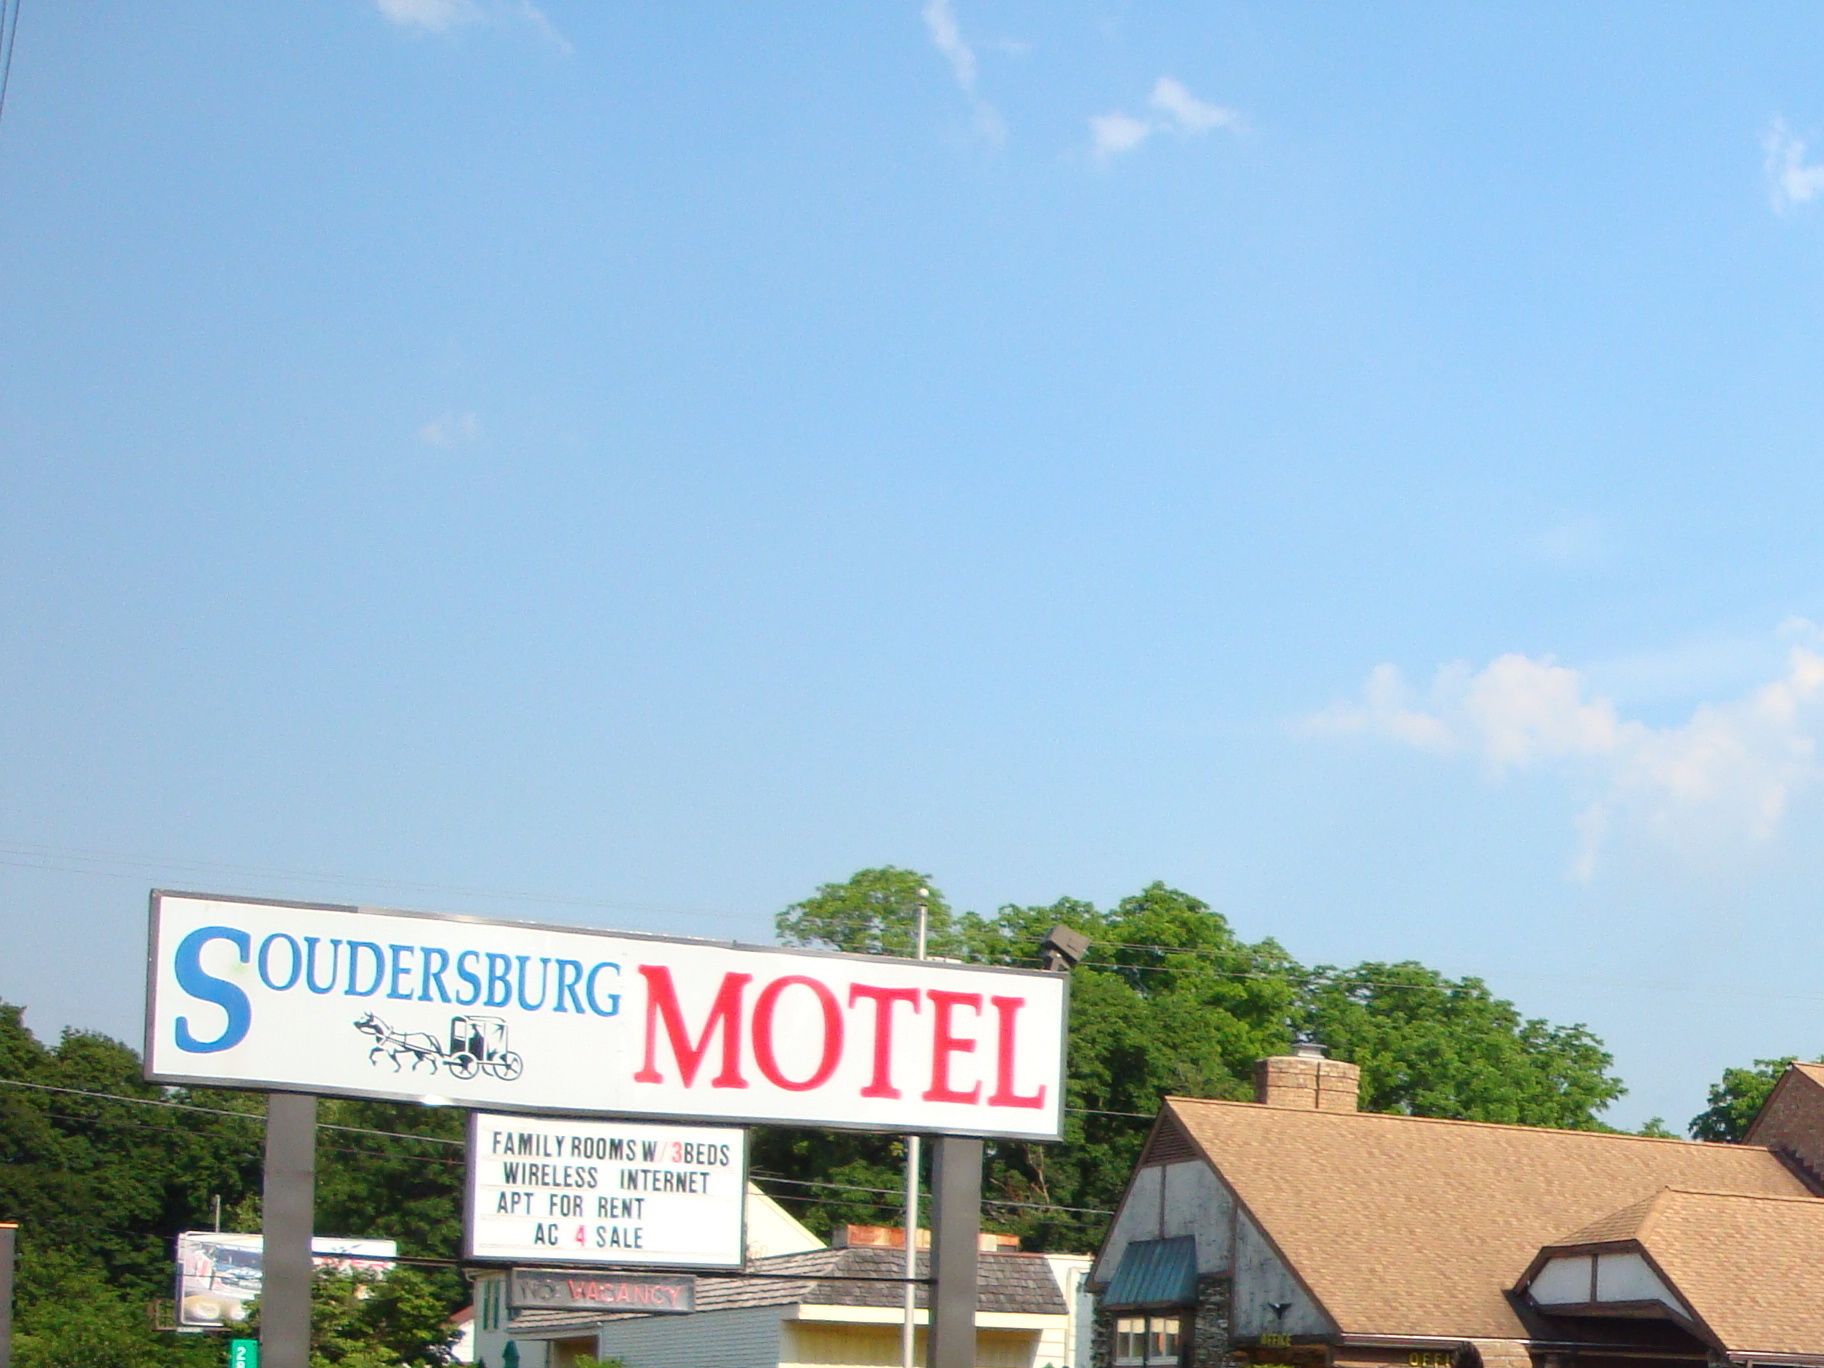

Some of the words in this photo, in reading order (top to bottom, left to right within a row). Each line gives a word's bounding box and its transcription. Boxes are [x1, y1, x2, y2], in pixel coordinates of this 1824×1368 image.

[174, 925, 623, 1054] SOUDERSBURG
[633, 964, 1047, 1111] MOTEL
[492, 1131, 566, 1157] FAMILY
[571, 1136, 636, 1161] ROOMS
[503, 1161, 598, 1189] WIRELESS
[620, 1168, 711, 1194] INTERNET
[496, 1191, 534, 1215] APT
[549, 1194, 584, 1218] FOR
[598, 1196, 645, 1220] RENT
[534, 1222, 559, 1246] AC
[575, 1224, 586, 1246] 4
[596, 1226, 643, 1249] SALE
[567, 1279, 684, 1308] VACANCY
[1408, 1351, 1456, 1367] OFFI
